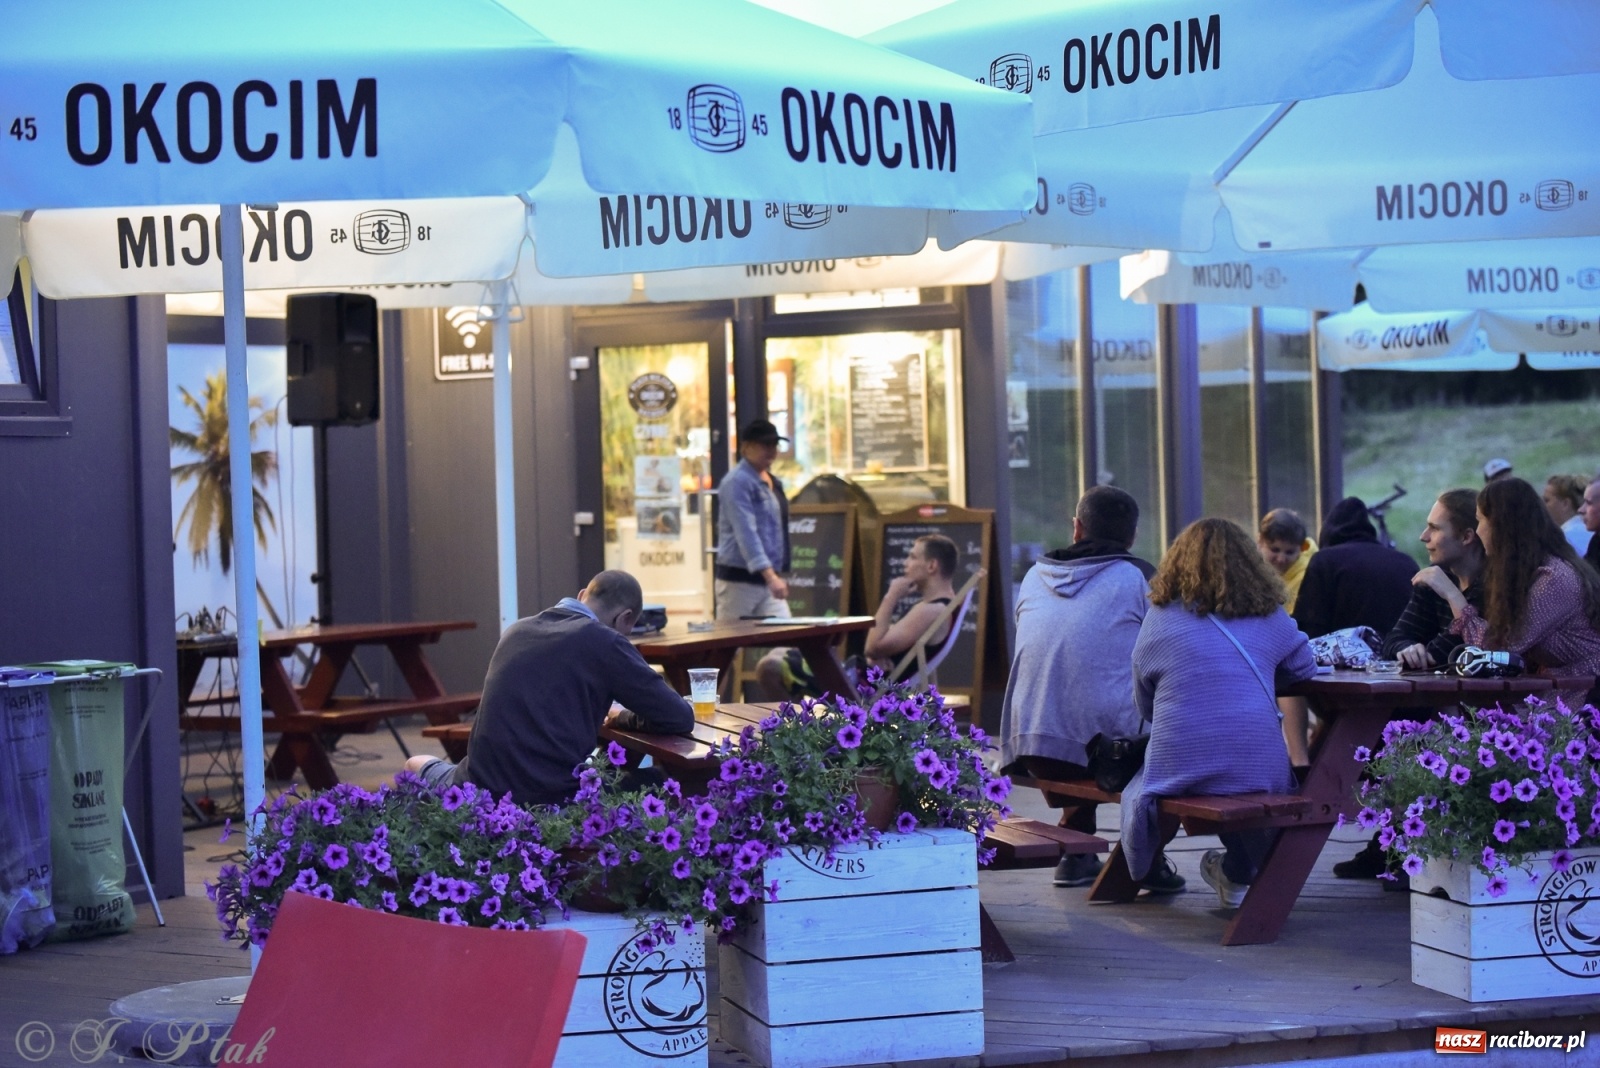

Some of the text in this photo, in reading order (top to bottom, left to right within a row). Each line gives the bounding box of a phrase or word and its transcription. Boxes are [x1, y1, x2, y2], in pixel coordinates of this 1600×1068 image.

[1036, 14, 1221, 94] 45 OKOCIM
[9, 78, 379, 167] 45 OKOCIM
[667, 86, 957, 173] 18 45 OKOCIM
[662, 1028, 707, 1051] APPLE
